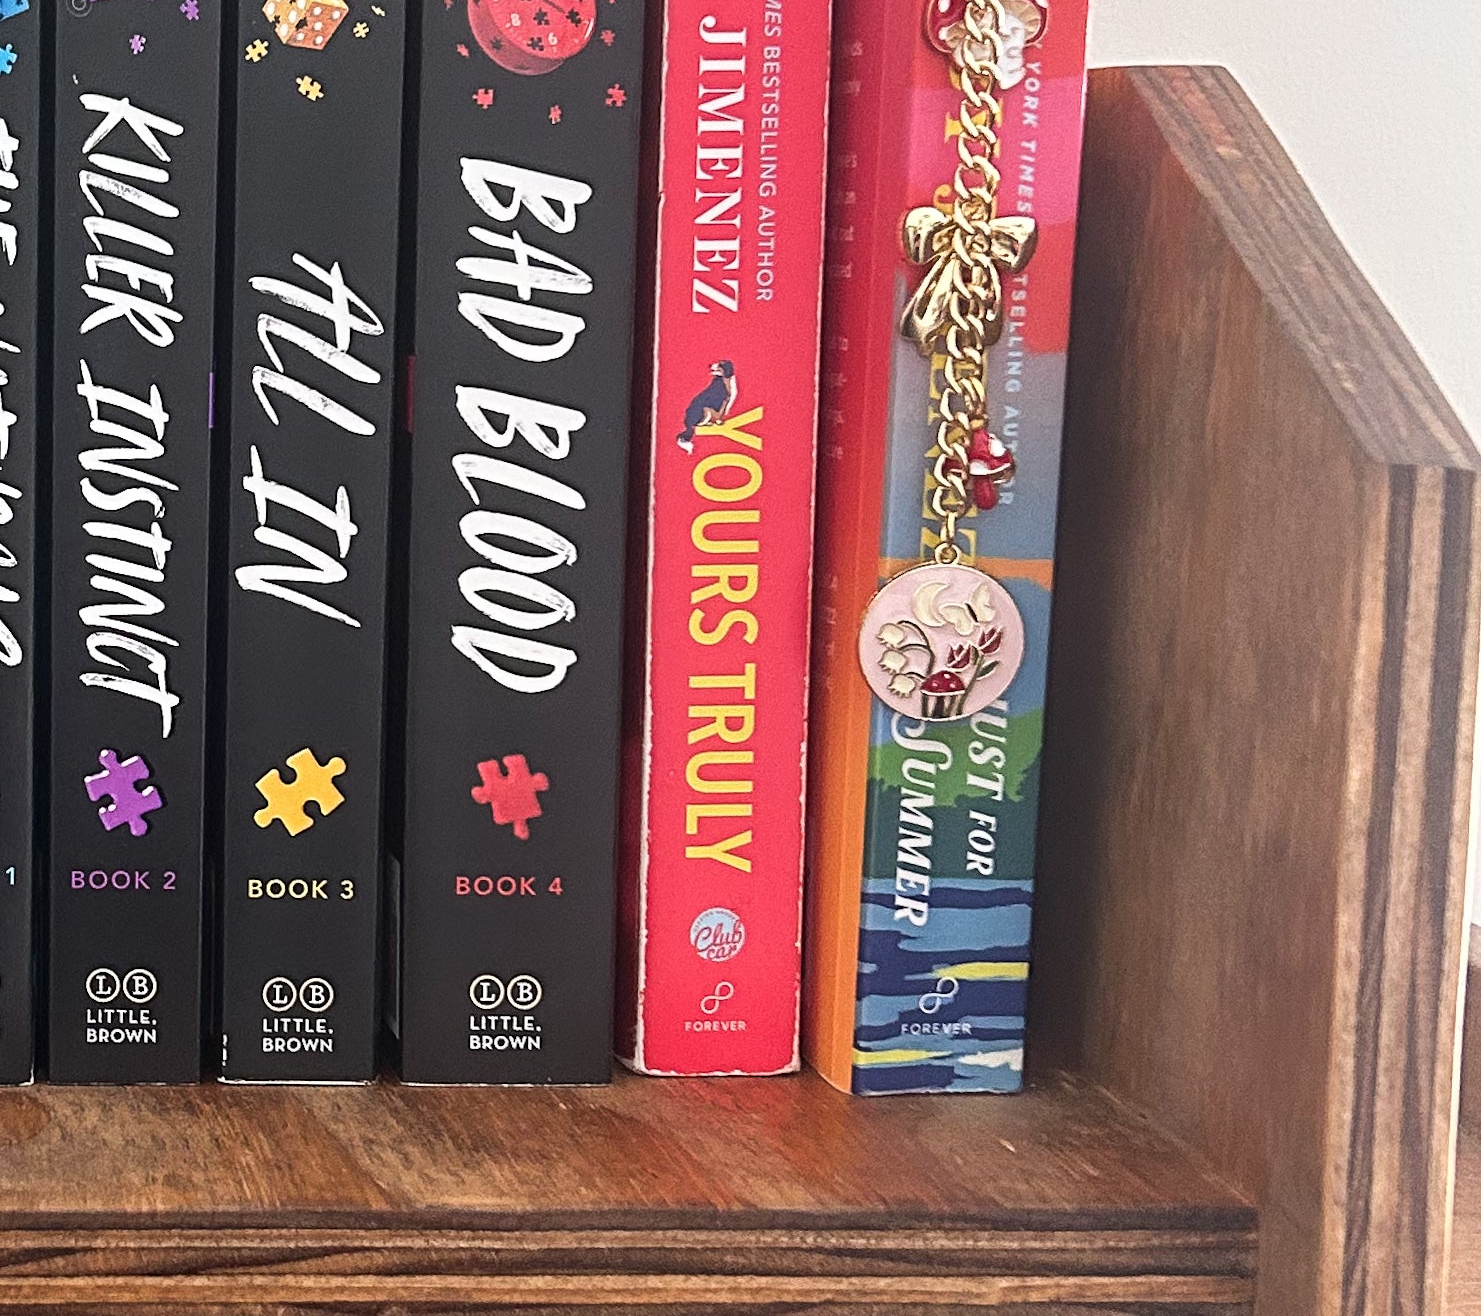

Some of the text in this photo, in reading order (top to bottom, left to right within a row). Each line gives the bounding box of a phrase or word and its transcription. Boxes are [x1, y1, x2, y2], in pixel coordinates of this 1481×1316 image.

[1022, 62, 1041, 126] YORK
[758, 46, 781, 197] BESTSELLING
[691, 15, 748, 314] JIMENEZ
[1016, 139, 1038, 214] TIMES
[754, 205, 776, 303] AUTHOR
[1004, 274, 1029, 393] TSELLING
[76, 92, 184, 739] KILLER INSTINCT
[450, 155, 594, 694] BAD BLOOD
[234, 252, 384, 629] ALL IN
[688, 404, 766, 646] YOURS
[684, 661, 757, 874] TRULY
[890, 711, 954, 927] SUMMER
[966, 809, 998, 876] FOR
[7, 867, 17, 886] 1
[70, 869, 177, 891] BOOK 2
[247, 879, 355, 900] BOOK 3
[455, 875, 564, 897] BOOK 4
[694, 919, 742, 952] Club
[85, 1009, 157, 1026] LITTLE,
[85, 1029, 158, 1044] BROWN
[262, 1018, 335, 1034] LITTLE,
[469, 1015, 543, 1032] LITTLE,
[684, 1020, 747, 1032] FOREVER
[900, 1023, 972, 1036] FOREVER
[261, 1037, 334, 1053] BROWN
[468, 1035, 542, 1050] BROWN
